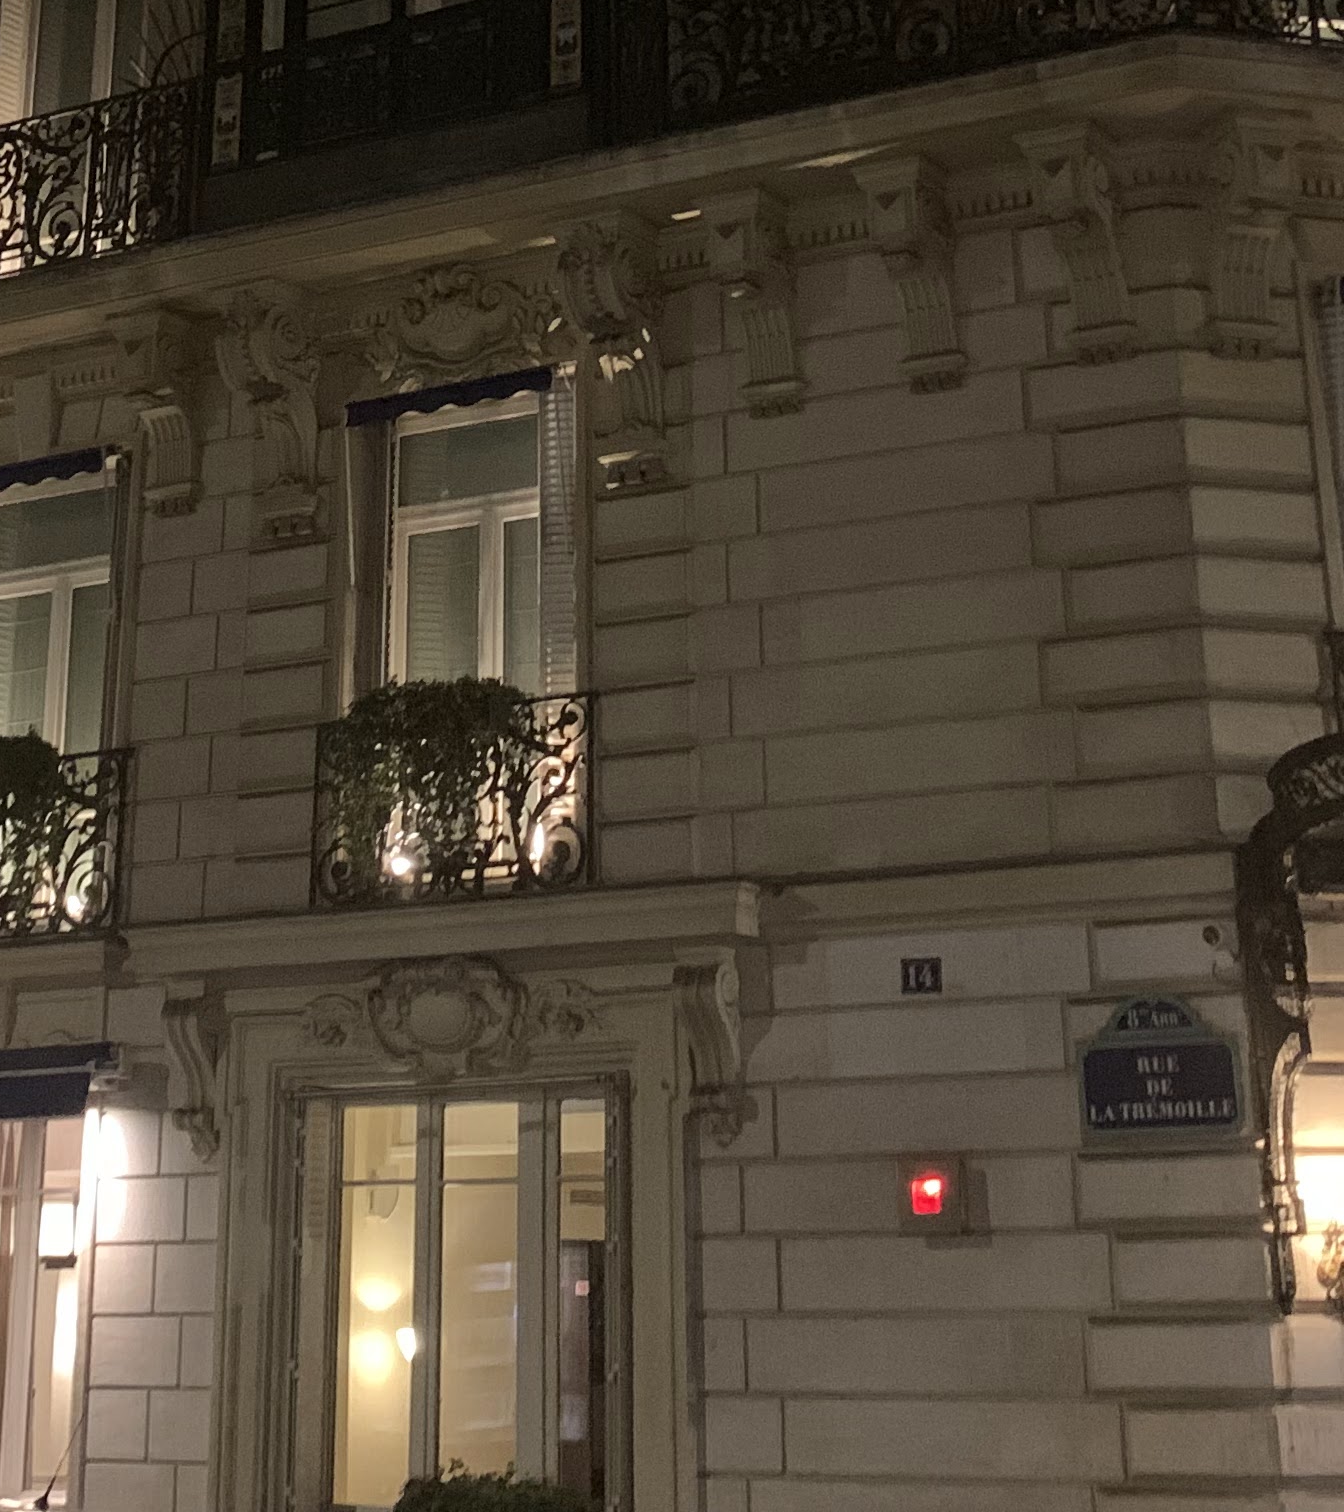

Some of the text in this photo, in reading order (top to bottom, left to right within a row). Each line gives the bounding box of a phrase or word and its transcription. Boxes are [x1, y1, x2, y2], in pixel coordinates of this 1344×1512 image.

[908, 964, 932, 988] 14
[1136, 1054, 1180, 1074] RUE
[1146, 1077, 1174, 1097] DE
[1089, 1104, 1116, 1123] LA
